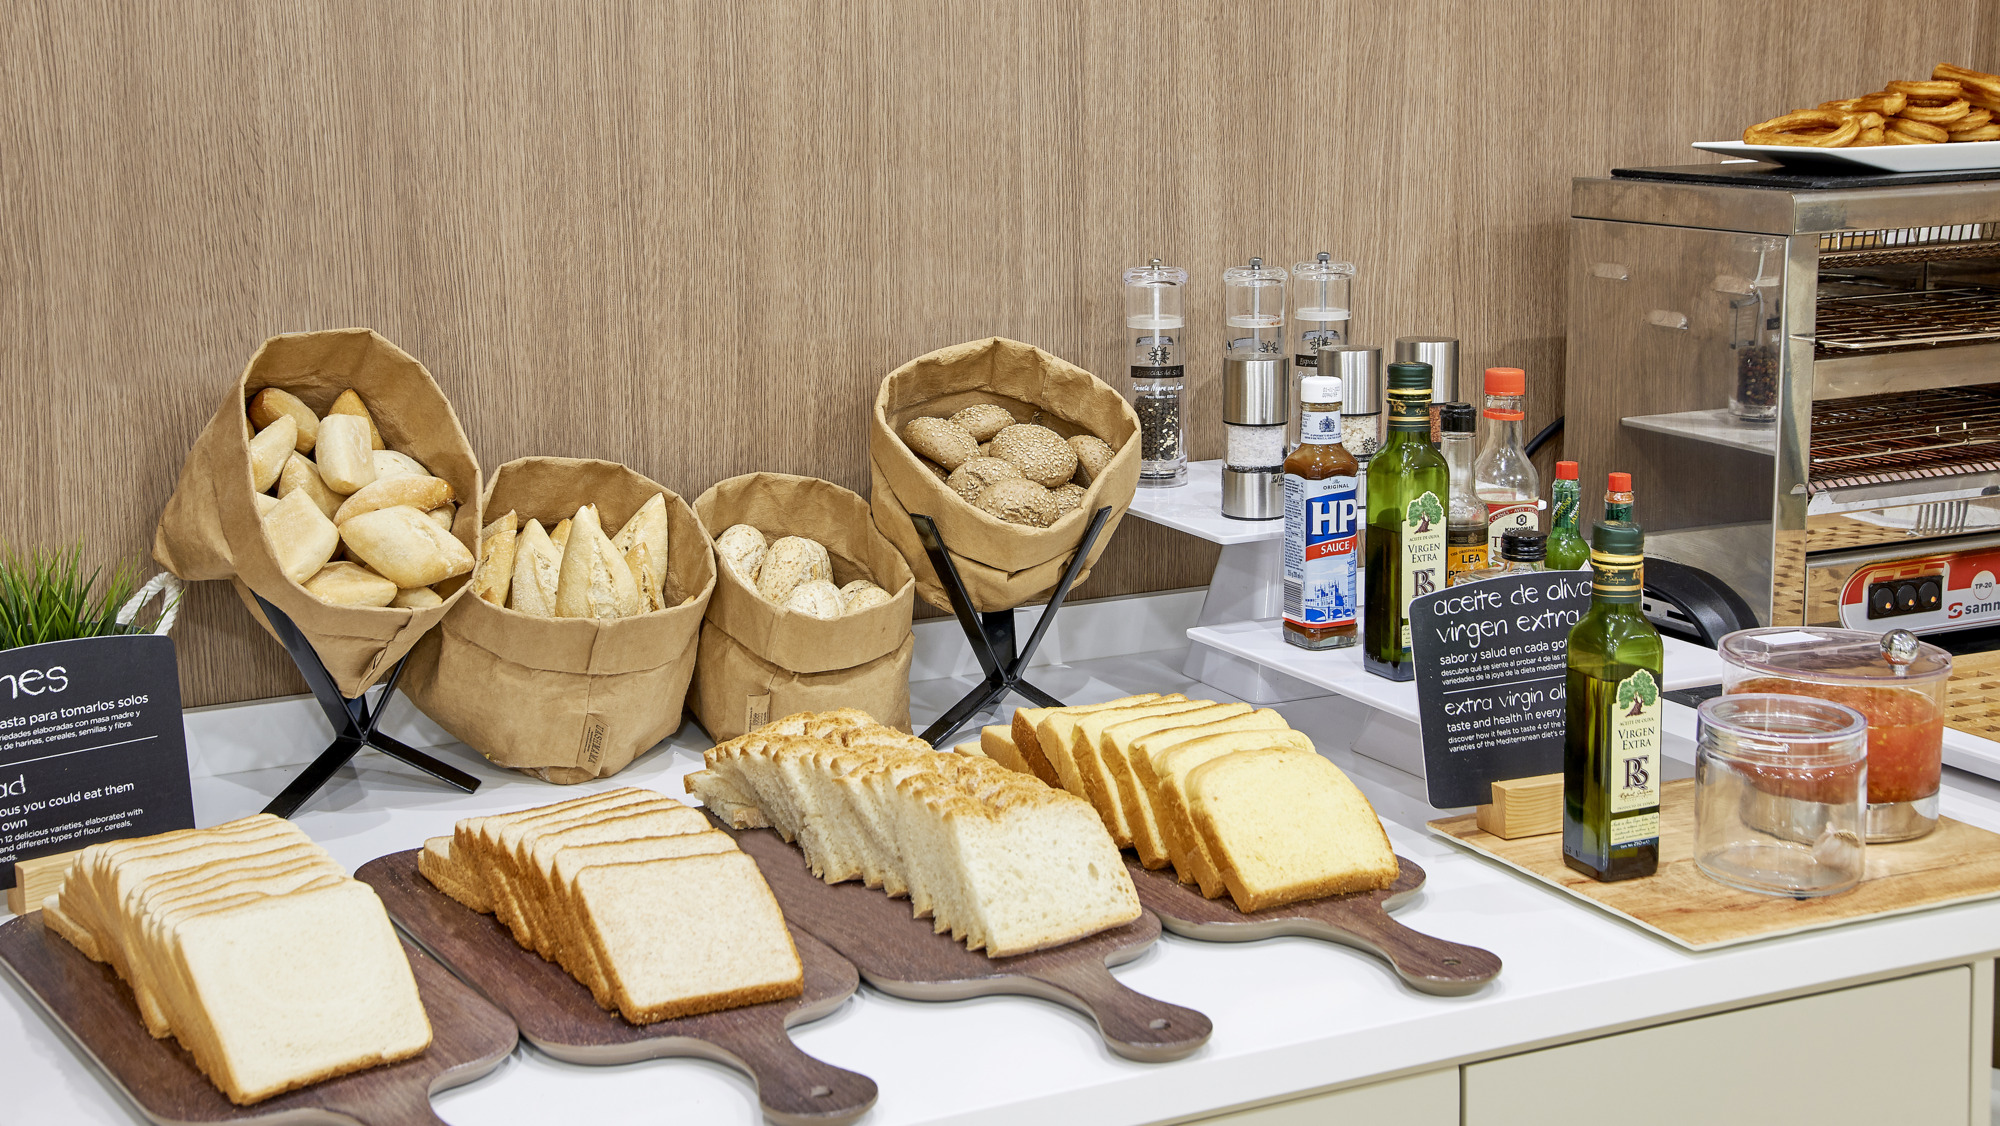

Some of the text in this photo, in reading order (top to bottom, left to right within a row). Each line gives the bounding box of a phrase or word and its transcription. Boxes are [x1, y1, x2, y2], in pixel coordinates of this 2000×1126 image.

[1311, 499, 1357, 536] HP
[1320, 540, 1350, 555] SAUCE
[1407, 543, 1441, 554] VIRGEN
[1412, 553, 1438, 564] EXTRA
[1461, 553, 1481, 564] LEA
[1433, 577, 1593, 616] aceite de oliva
[1975, 582, 1993, 590] TP-20
[1436, 620, 1508, 649] virgen
[1516, 608, 1580, 632] extra
[1440, 653, 1469, 666] sabor
[1471, 652, 1478, 663] y
[1480, 645, 1507, 660] salud
[1509, 646, 1522, 656] en
[1524, 640, 1549, 653] cada
[1441, 667, 1469, 677] descubre
[1470, 664, 1482, 673] qué
[1491, 662, 1509, 670] siente
[1516, 658, 1536, 667] probar
[1442, 675, 1475, 686] variedades
[1476, 673, 1484, 681] de
[1491, 671, 1505, 680] joya
[1505, 669, 1513, 677] de
[1520, 666, 1536, 674] dieta
[29, 711, 58, 726] para
[60, 700, 115, 719] tomarlos
[117, 694, 149, 708] solos
[1444, 697, 1493, 716] extra
[1499, 687, 1544, 711] virgin
[32, 722, 74, 736] elaboradas
[74, 719, 89, 728] con
[90, 715, 110, 725] masa
[110, 710, 135, 721] madre
[135, 710, 141, 718] y
[1447, 708, 1561, 733] taste and health in every
[1448, 734, 1475, 744] discover
[1476, 731, 1490, 740] how
[1491, 730, 1496, 738] it
[1496, 728, 1512, 737] feels
[1512, 726, 1520, 734] to
[1520, 724, 1536, 733] taste
[1550, 720, 1561, 728] the
[3, 742, 15, 751] de
[15, 737, 45, 749] harinas,
[45, 731, 78, 743] cereales,
[78, 725, 108, 737] semillas
[108, 724, 114, 732] y
[114, 721, 133, 730] fibra.
[1449, 743, 1476, 753] varieties
[1476, 741, 1484, 749] of
[1484, 739, 1495, 747] the
[1496, 733, 1541, 746] Mediterranean
[1541, 730, 1558, 739] diet's
[1618, 726, 1655, 740] VIRGEN
[1622, 738, 1652, 751] EXTRA
[23, 800, 46, 815] you
[48, 791, 81, 807] could
[83, 787, 103, 800] eat
[104, 782, 135, 796] them
[0, 844, 15, 854] and
[16, 837, 50, 851] different
[50, 832, 73, 844] types
[73, 829, 83, 838] of
[82, 826, 104, 837] flour,
[104, 820, 133, 832] cereals,
[1, 818, 28, 832] own
[4, 834, 13, 843] 12
[14, 828, 49, 841] delicious
[49, 821, 84, 834] varieties,
[85, 811, 126, 826] elaborated
[126, 808, 144, 817] with
